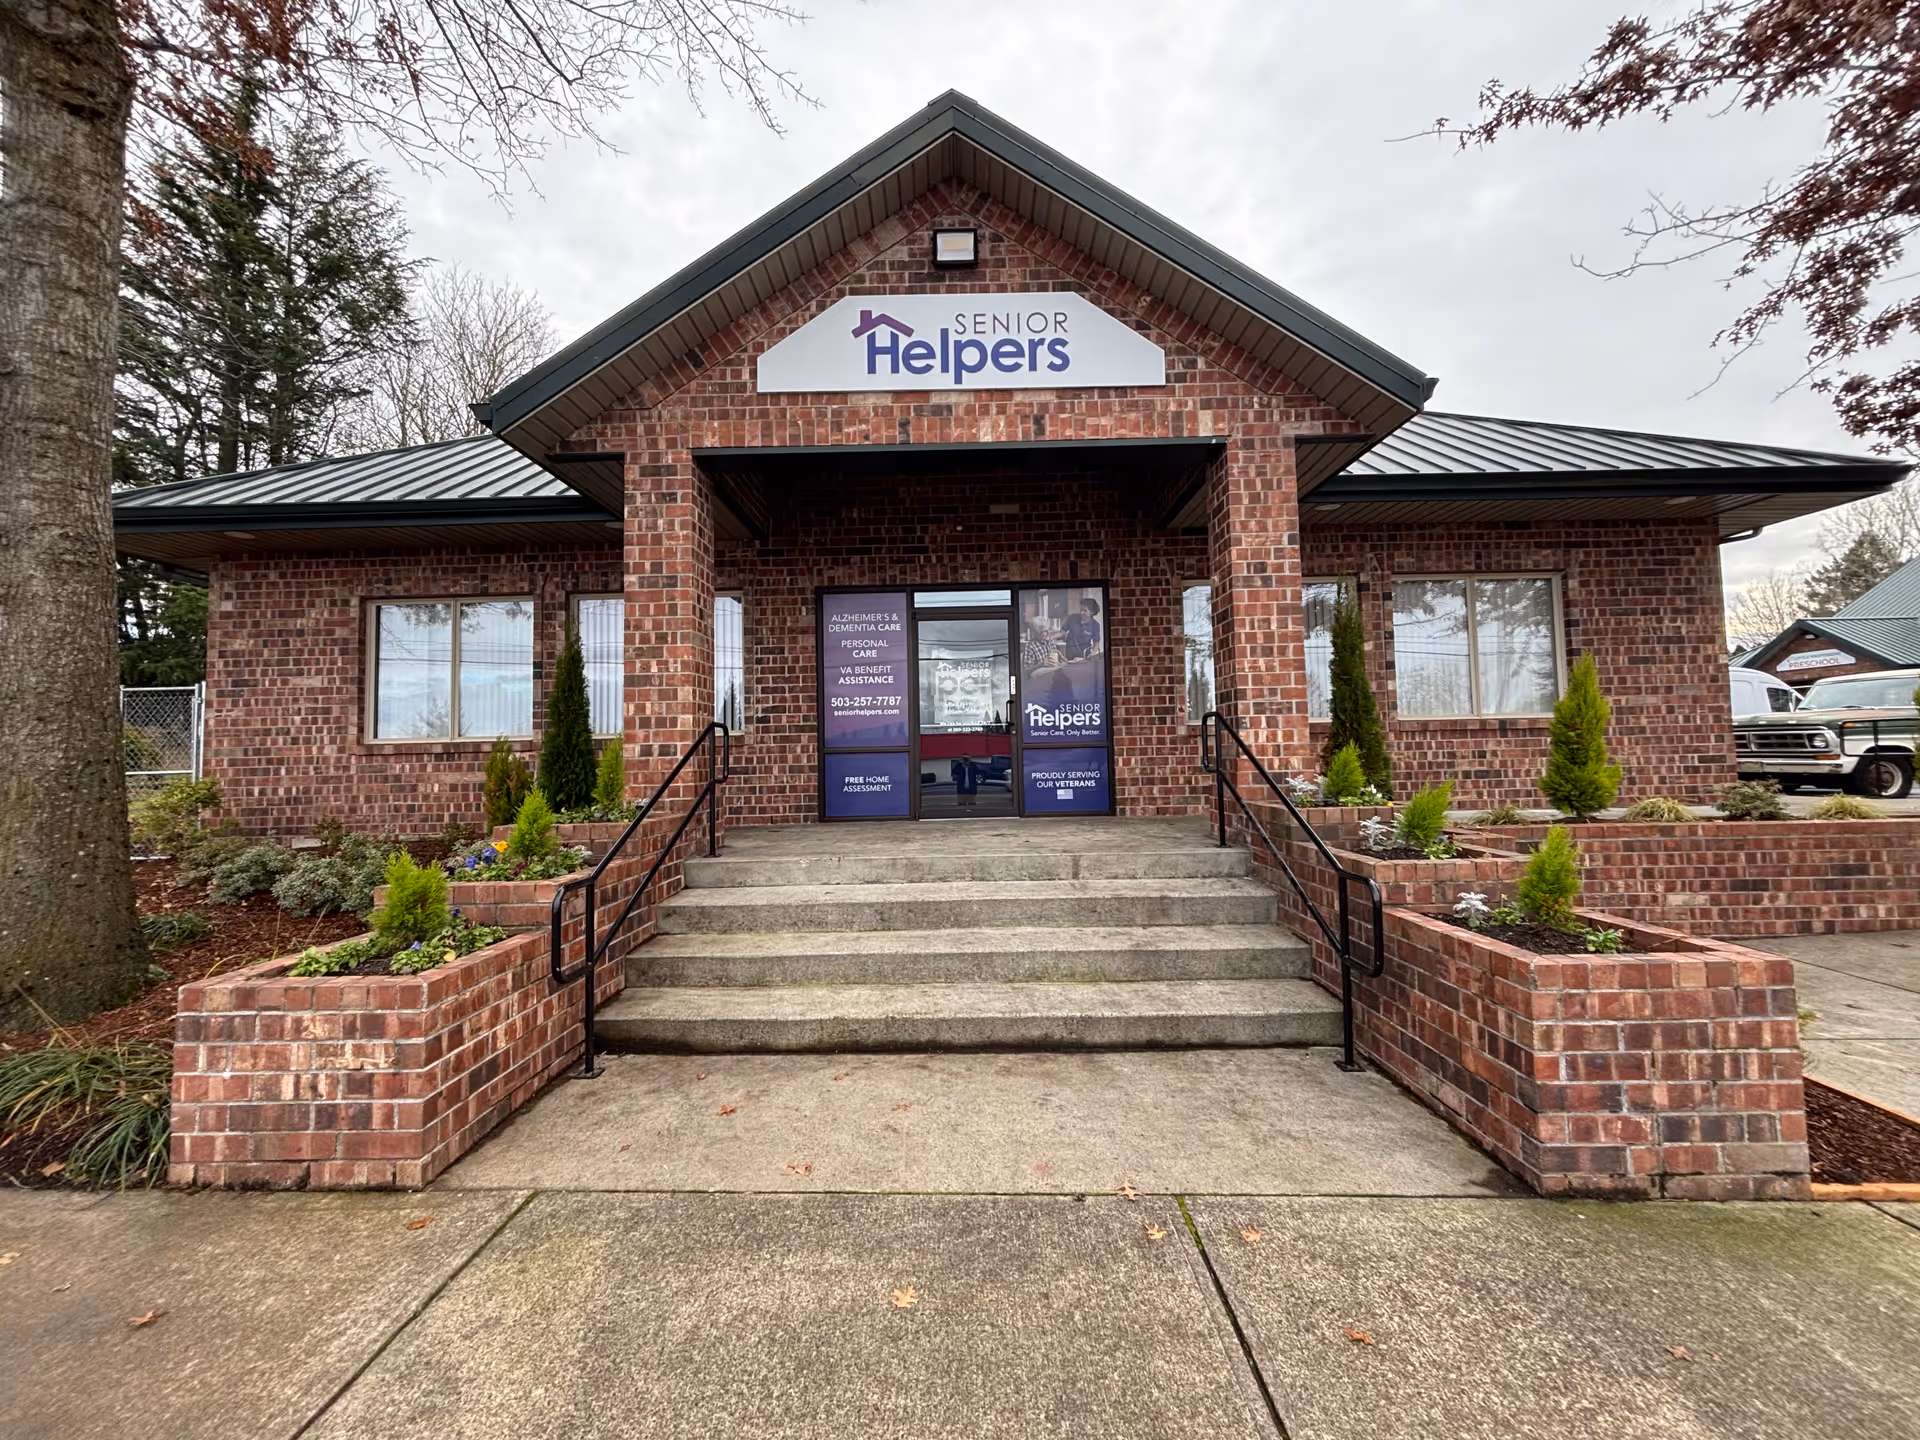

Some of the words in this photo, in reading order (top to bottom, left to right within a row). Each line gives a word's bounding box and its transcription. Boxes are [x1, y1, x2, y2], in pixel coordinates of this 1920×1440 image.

[954, 312, 1069, 335] SENIOR
[867, 328, 1071, 384] Helpers
[831, 613, 889, 622] ALZHEIMER'S
[891, 613, 899, 621] &
[828, 624, 876, 632] DEMENTIA
[877, 623, 902, 631] CARE
[841, 640, 889, 648] PERSONAL
[852, 649, 878, 658] CARE
[961, 661, 990, 669] SENIOR
[1788, 657, 1840, 668] PRESCHOOL
[840, 666, 853, 675] VA
[854, 665, 892, 674] BENEFIT
[838, 675, 894, 685] ASSISTANCE
[830, 696, 902, 707] 503-257-7787
[1059, 703, 1101, 712] SENIOR
[833, 708, 900, 717] seniorhelpers.com
[1030, 709, 1101, 730] Helpers
[845, 776, 864, 784] FREE
[865, 775, 890, 783] HOME
[1031, 771, 1066, 779] PROUDLY
[843, 784, 893, 793] ASSESSMENT
